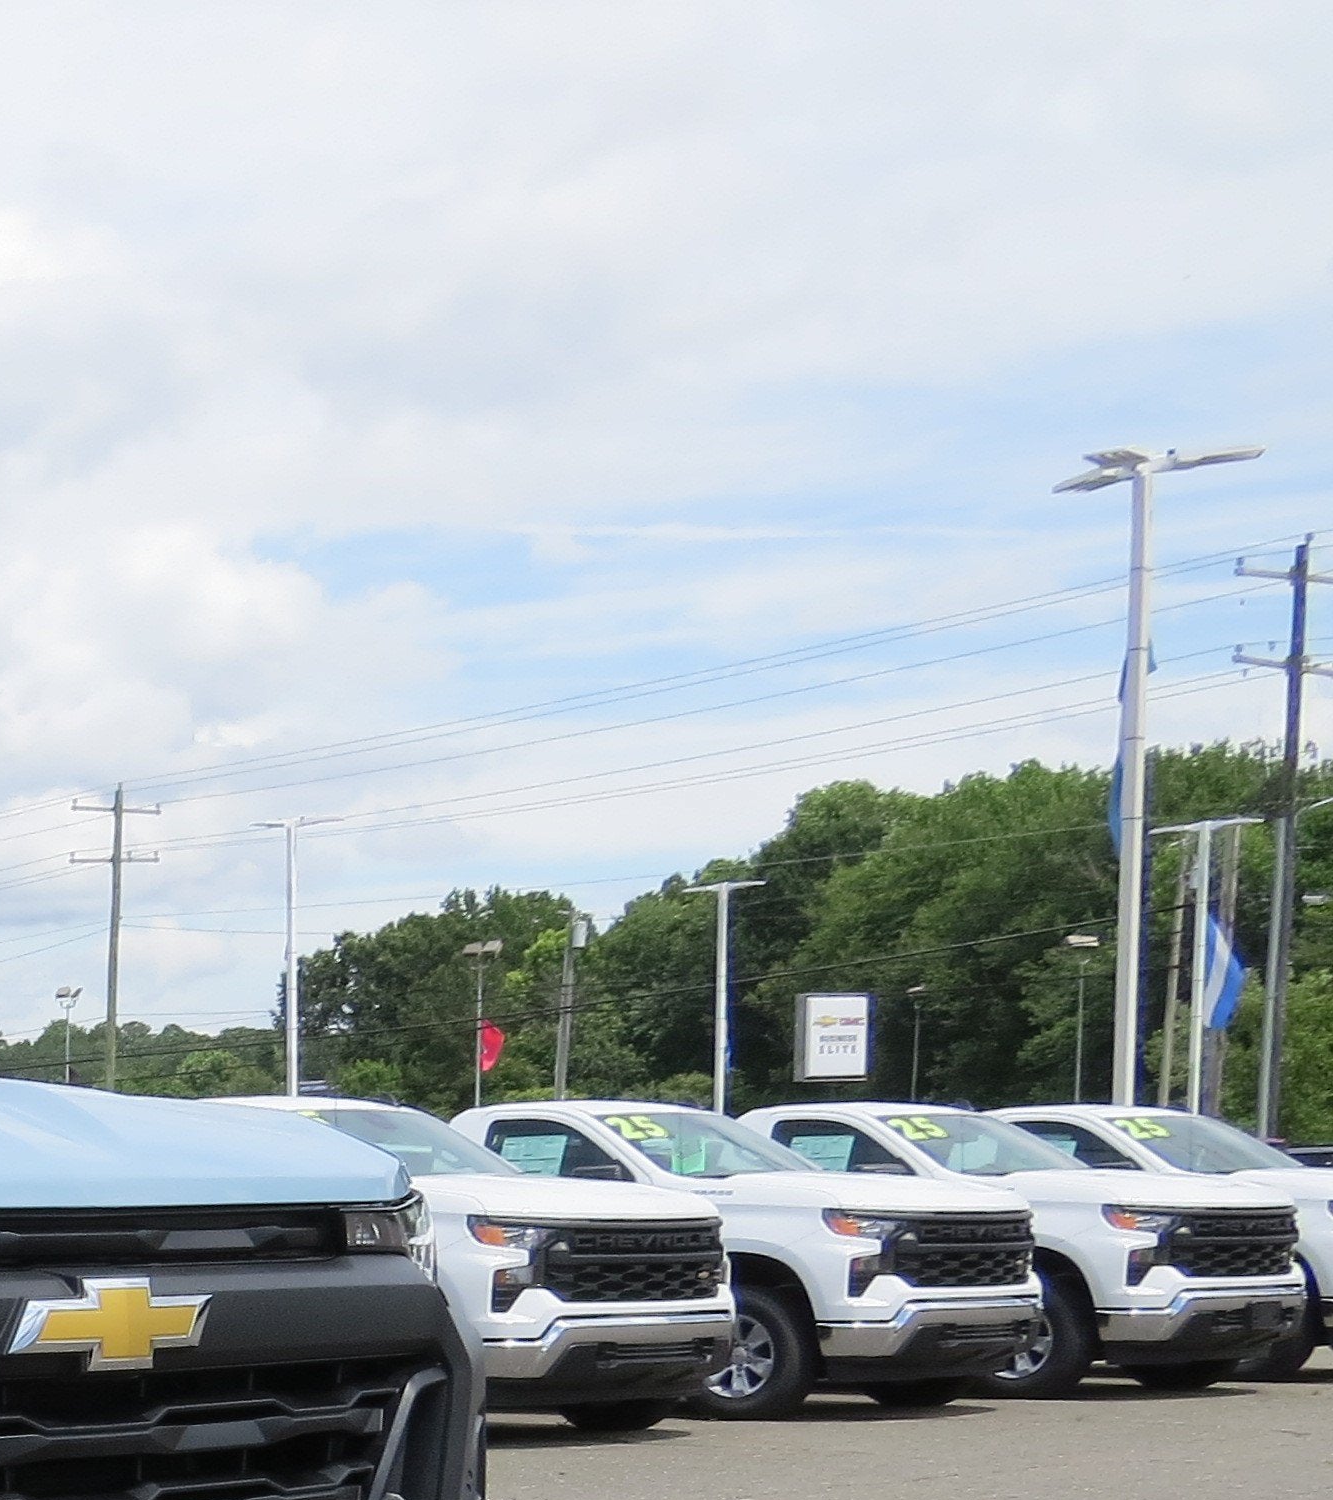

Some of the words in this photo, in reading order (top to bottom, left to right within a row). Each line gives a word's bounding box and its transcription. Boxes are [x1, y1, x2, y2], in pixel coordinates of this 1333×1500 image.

[818, 1045, 857, 1054] ELITE
[603, 1114, 670, 1141] 25
[886, 1116, 949, 1141] 25
[1113, 1117, 1173, 1140] 25
